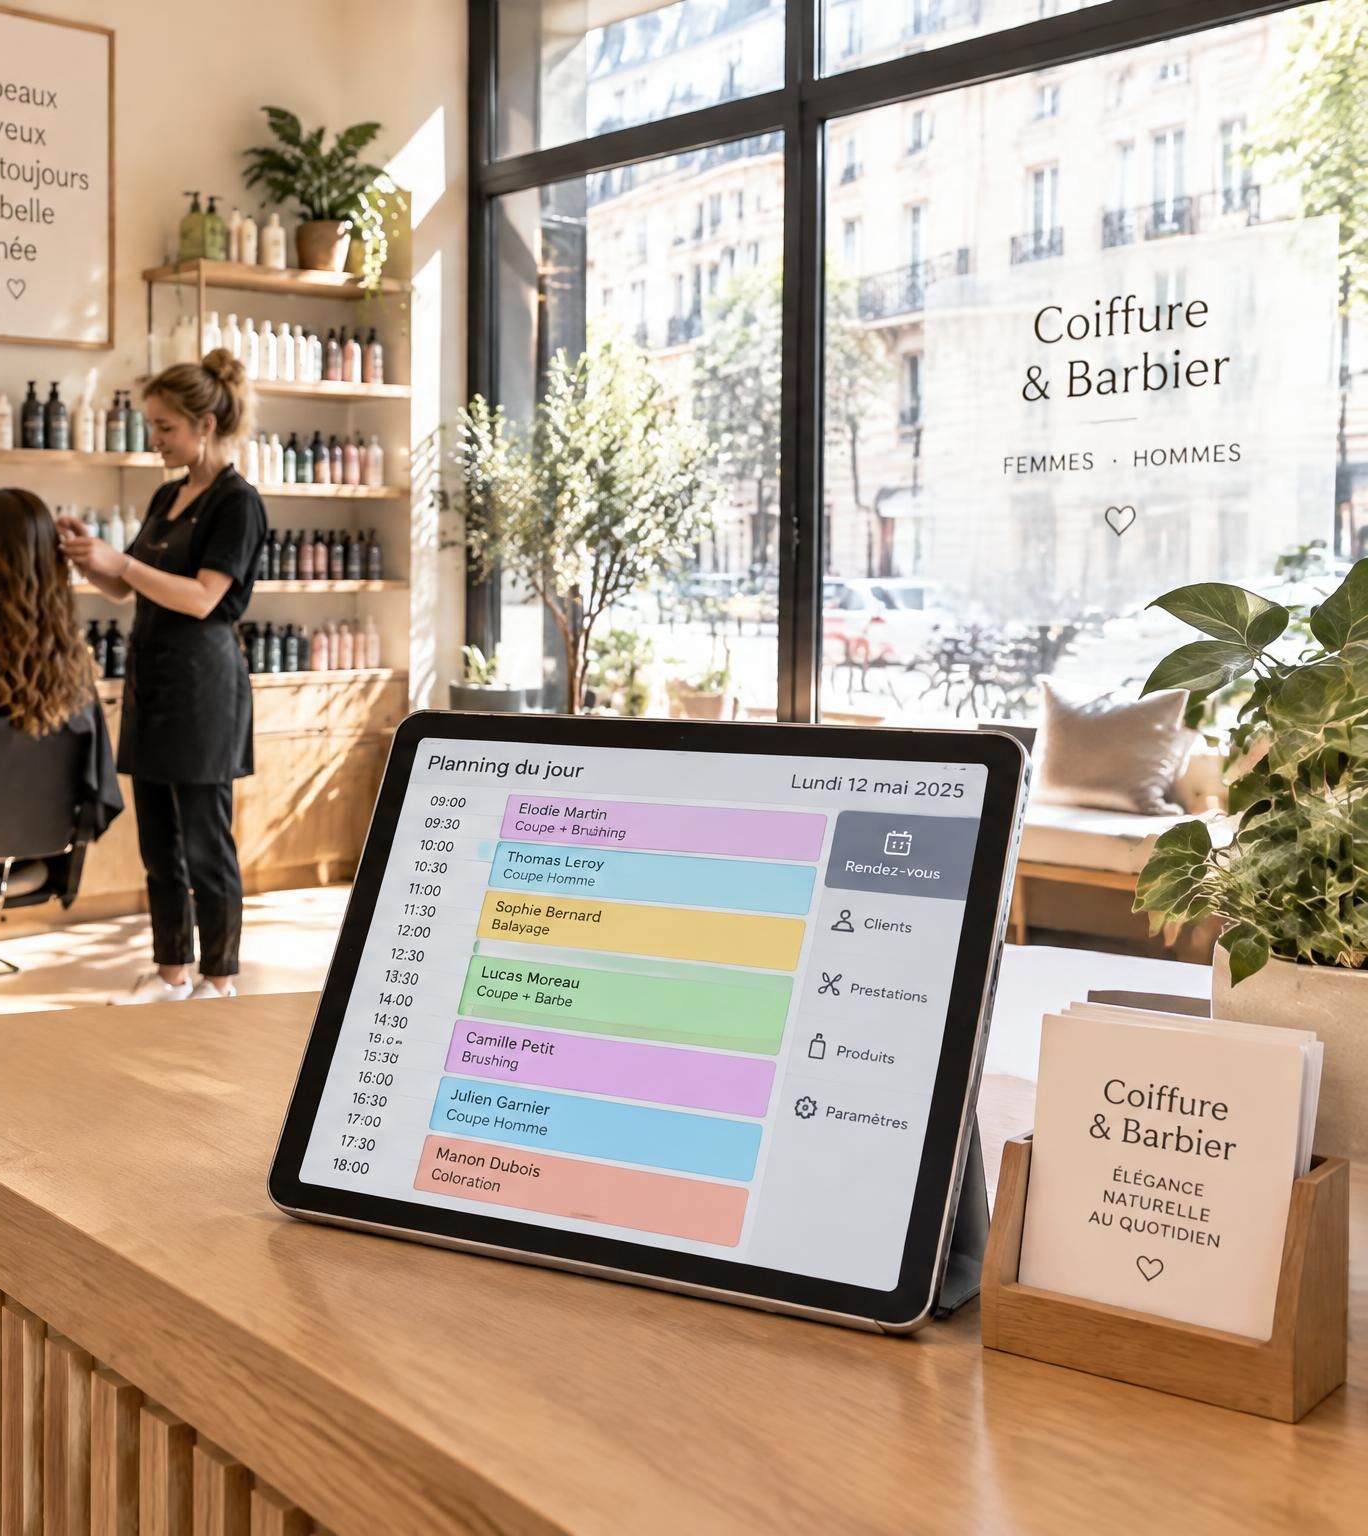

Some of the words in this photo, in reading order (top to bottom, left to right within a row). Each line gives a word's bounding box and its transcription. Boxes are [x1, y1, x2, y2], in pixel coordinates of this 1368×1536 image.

[0, 159, 89, 190] toujours
[0, 194, 54, 224] belle
[1034, 295, 1208, 343] Coiffure
[1023, 366, 1050, 401] &
[1067, 350, 1230, 397] Barbier
[1004, 452, 1093, 474] FEMMES
[1134, 443, 1240, 467] HOMMES
[428, 756, 509, 777] Planning
[515, 760, 539, 775] du
[543, 761, 584, 780] jour
[792, 774, 842, 790] Lundi
[849, 778, 867, 792] 12
[874, 781, 908, 794] mai
[915, 782, 964, 798] 2025
[431, 796, 466, 807] 09:00
[519, 803, 560, 816] Elodie
[564, 807, 607, 820] Martin
[425, 818, 460, 830] 09:30
[515, 821, 555, 835] Coupe
[421, 840, 454, 852] 10:00
[415, 861, 447, 873] 10:30
[508, 851, 560, 866] Thomas
[565, 856, 604, 872] Leroy
[846, 861, 940, 879] Rendez-vous
[504, 869, 543, 883] Coupe
[547, 872, 595, 886] Homme
[410, 883, 441, 896] 11:00
[405, 904, 436, 917] 11:30
[496, 901, 541, 916] Sophie
[546, 906, 602, 922] Bernard
[398, 925, 430, 938] 12:00
[492, 919, 549, 936] Balayage
[864, 918, 911, 933] Clients
[392, 948, 424, 962] 12:30
[386, 970, 418, 985] 13:30
[482, 966, 522, 982] Lucas
[527, 972, 579, 989] Moreau
[477, 985, 518, 1002] Coupe
[535, 992, 572, 1007] Barbe
[851, 983, 927, 1003] Prestations
[467, 1032, 517, 1049] Camille
[522, 1039, 554, 1055] Petit
[462, 1051, 518, 1071] Brushing
[837, 1045, 894, 1064] Produits
[359, 1072, 393, 1086] 16:00
[353, 1093, 387, 1107] 16:30
[451, 1089, 491, 1106] Julien
[497, 1096, 550, 1115] Garnier
[1103, 1079, 1228, 1121] Coiffure
[348, 1113, 381, 1127] 17:00
[447, 1109, 489, 1127] Coupe
[494, 1116, 547, 1135] Homme
[342, 1135, 375, 1151] 17:30
[1090, 1114, 1110, 1140] &
[1122, 1117, 1236, 1160] Barbier
[334, 1158, 369, 1174] 18:00
[436, 1147, 485, 1167] Manon
[490, 1157, 540, 1177] Dubois
[432, 1167, 502, 1192] Coloration
[1111, 1165, 1206, 1198] ÉLÉGANCE
[1102, 1189, 1210, 1223] NATURELLE
[1088, 1211, 1113, 1226] AU
[1120, 1215, 1220, 1248] QUOTIDIEN
